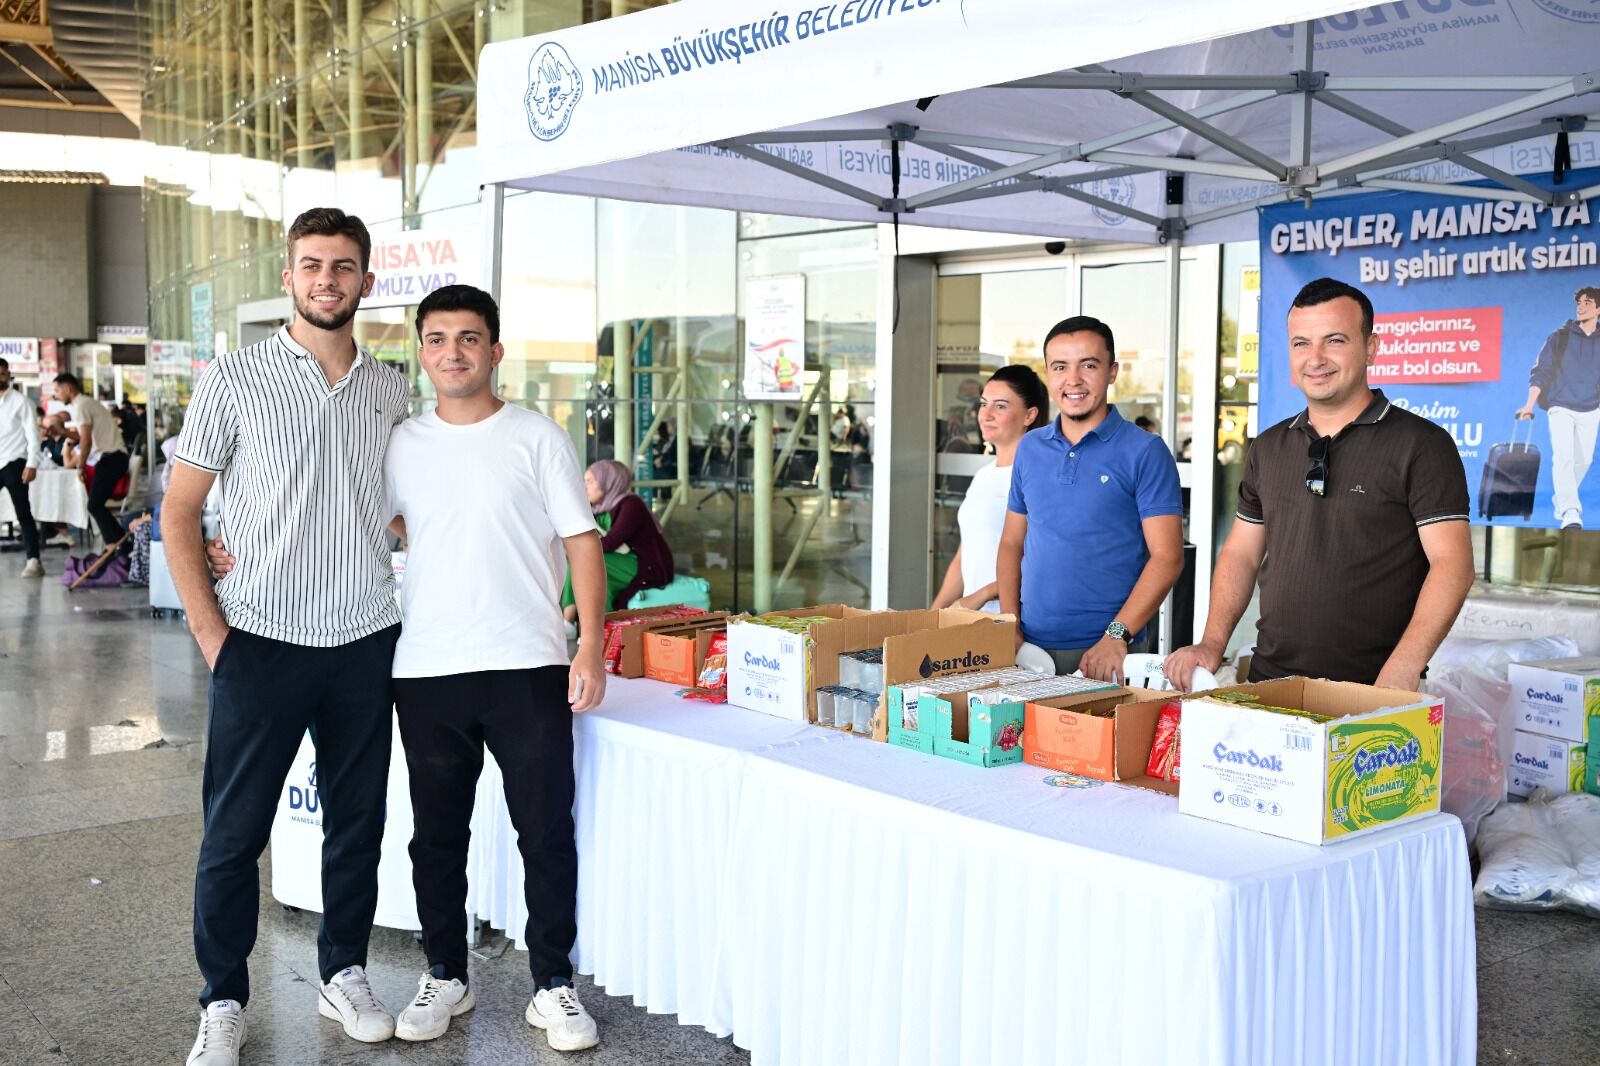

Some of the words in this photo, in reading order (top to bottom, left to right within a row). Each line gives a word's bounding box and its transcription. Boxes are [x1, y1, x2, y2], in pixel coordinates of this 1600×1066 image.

[592, 51, 664, 94] MANİSA
[660, 11, 790, 76] BÜYÜKŞEHİR
[1270, 211, 1402, 257] GENÇLER,
[1360, 256, 1389, 284] Bu
[1394, 247, 1457, 285] şehir
[1462, 241, 1526, 276] artık
[1531, 234, 1597, 270] sizin
[1459, 340, 1481, 353] ve
[1402, 360, 1430, 376] bol
[1432, 358, 1482, 375] olsun.
[1442, 423, 1483, 447] LU
[744, 650, 781, 672] Çardak
[932, 650, 990, 672] sardes
[1526, 688, 1564, 704] Çardak
[1213, 741, 1283, 772] Çardak
[1353, 737, 1419, 780] Çardak
[1515, 752, 1549, 770] Çardak
